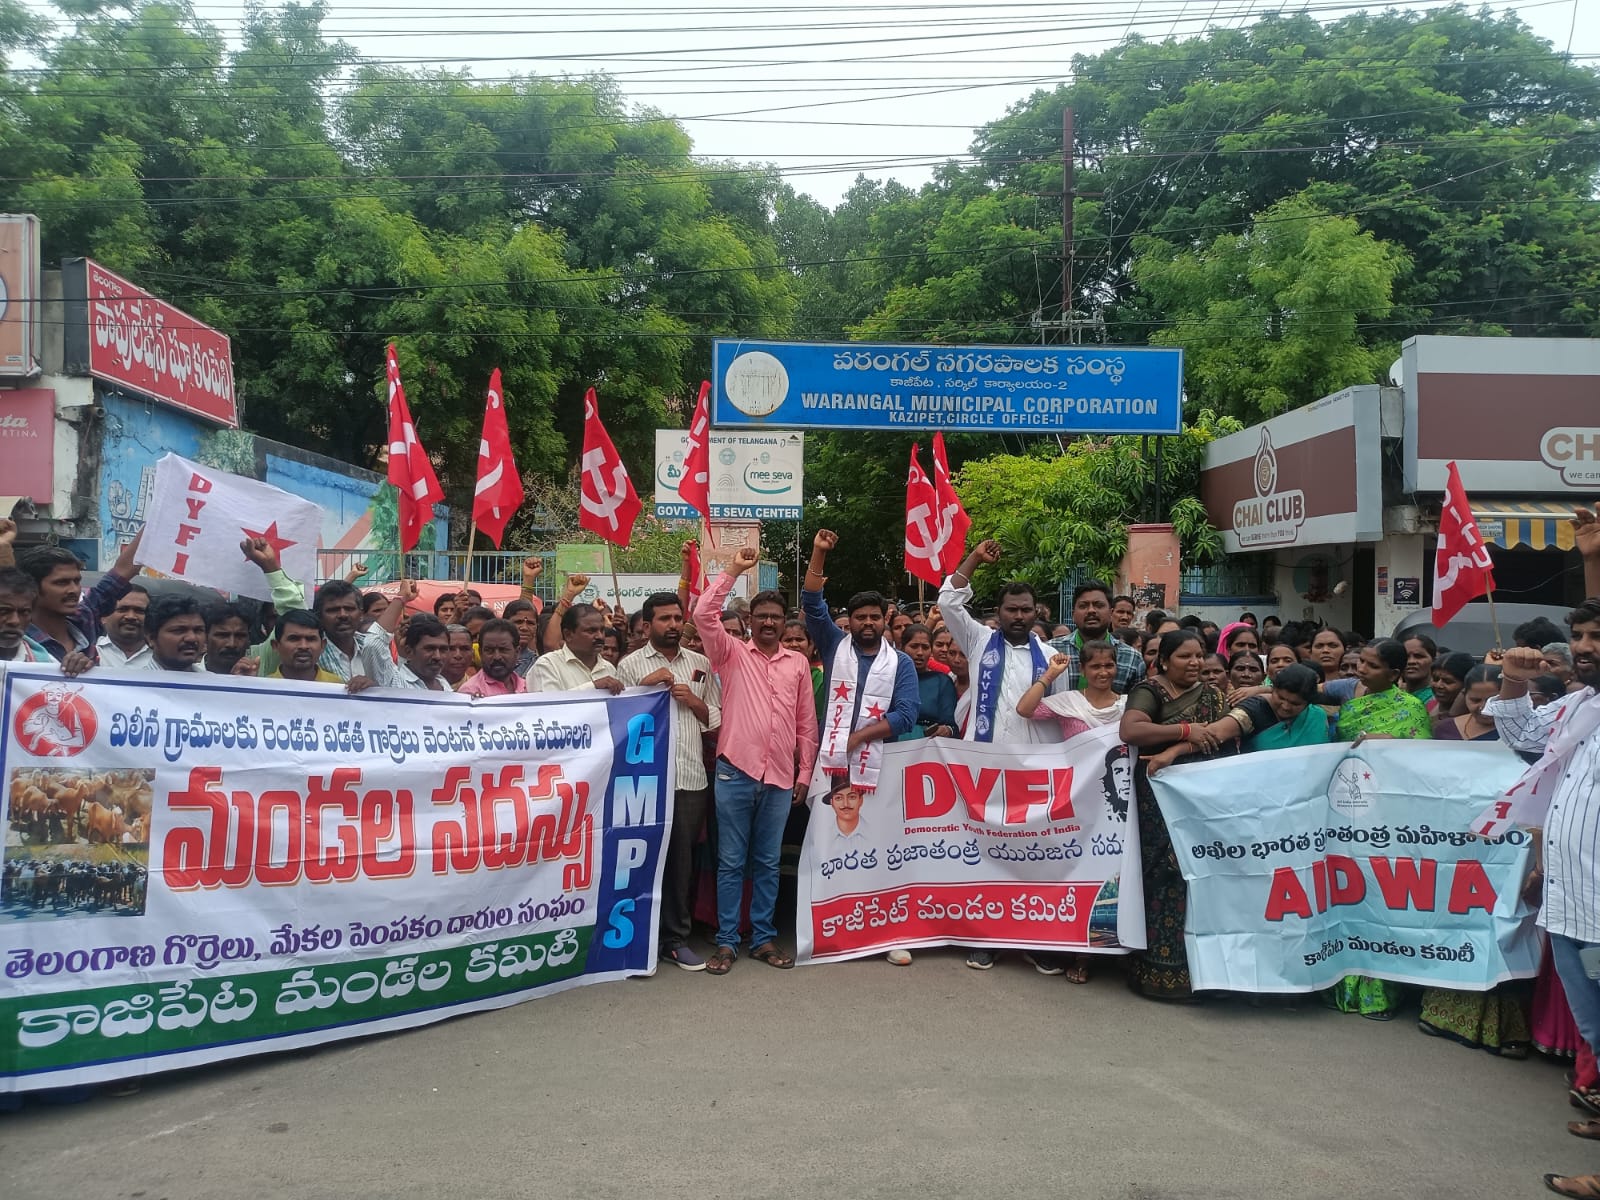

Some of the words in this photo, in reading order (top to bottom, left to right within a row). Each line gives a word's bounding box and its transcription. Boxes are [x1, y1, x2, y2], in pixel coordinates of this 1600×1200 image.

[833, 351, 932, 372] వరంగల్
[936, 353, 1059, 375] నగరపాలక
[1067, 357, 1126, 385] సంస్థ
[801, 392, 905, 411] WARANGAL
[911, 395, 1015, 413] MUNICIPAL
[1024, 398, 1157, 415] CORPORATION
[889, 411, 993, 426] KAZIPET,CIRCLE
[1002, 413, 1064, 425] OFFICE-II
[728, 437, 737, 445] OF
[738, 437, 778, 446] TELANGANA
[750, 471, 770, 480] mee
[772, 471, 793, 480] seva
[172, 472, 213, 575] DYFI
[657, 506, 690, 516] GOVT
[723, 507, 753, 518] SEVA
[755, 508, 800, 519] CENTER
[1234, 503, 1263, 528] CHAI
[1266, 495, 1303, 523] CLUB
[979, 670, 993, 713] KVPS
[110, 706, 160, 748] విలీన
[163, 712, 258, 762] గ్రామాలకు
[262, 717, 319, 752] రెండవ
[323, 720, 365, 753] విడత
[368, 724, 420, 764] గొర్రెలు
[423, 720, 476, 754] వెంటనే
[532, 718, 592, 750] చేయాలని
[828, 704, 843, 757] DYFI
[902, 761, 1075, 825] DYFI
[163, 766, 415, 890] మండల
[431, 764, 592, 891] సదస్సు
[602, 713, 659, 949] GMPS
[904, 824, 960, 835] Democratic
[986, 829, 1038, 838] Federation
[1041, 829, 1051, 837] of
[1054, 824, 1081, 835] India
[1191, 840, 1246, 860] అఖిల
[1251, 832, 1310, 859] భారత
[820, 848, 878, 879] భారత
[886, 839, 982, 872] ప్రజాతంత్ర
[987, 839, 1083, 862] యువజన
[1264, 854, 1498, 922] AIDWA
[821, 894, 910, 938] కాజీపేట్
[917, 893, 1005, 921] మండల
[1011, 886, 1077, 923] కమిటీ
[5, 943, 156, 979] తెలంగాణ
[270, 923, 342, 955] మేకల
[349, 915, 443, 947] పెంపకం
[447, 905, 513, 935] దారుల
[518, 895, 586, 925] సంఘం
[1348, 936, 1415, 957] మండల
[274, 956, 452, 1015] మండల
